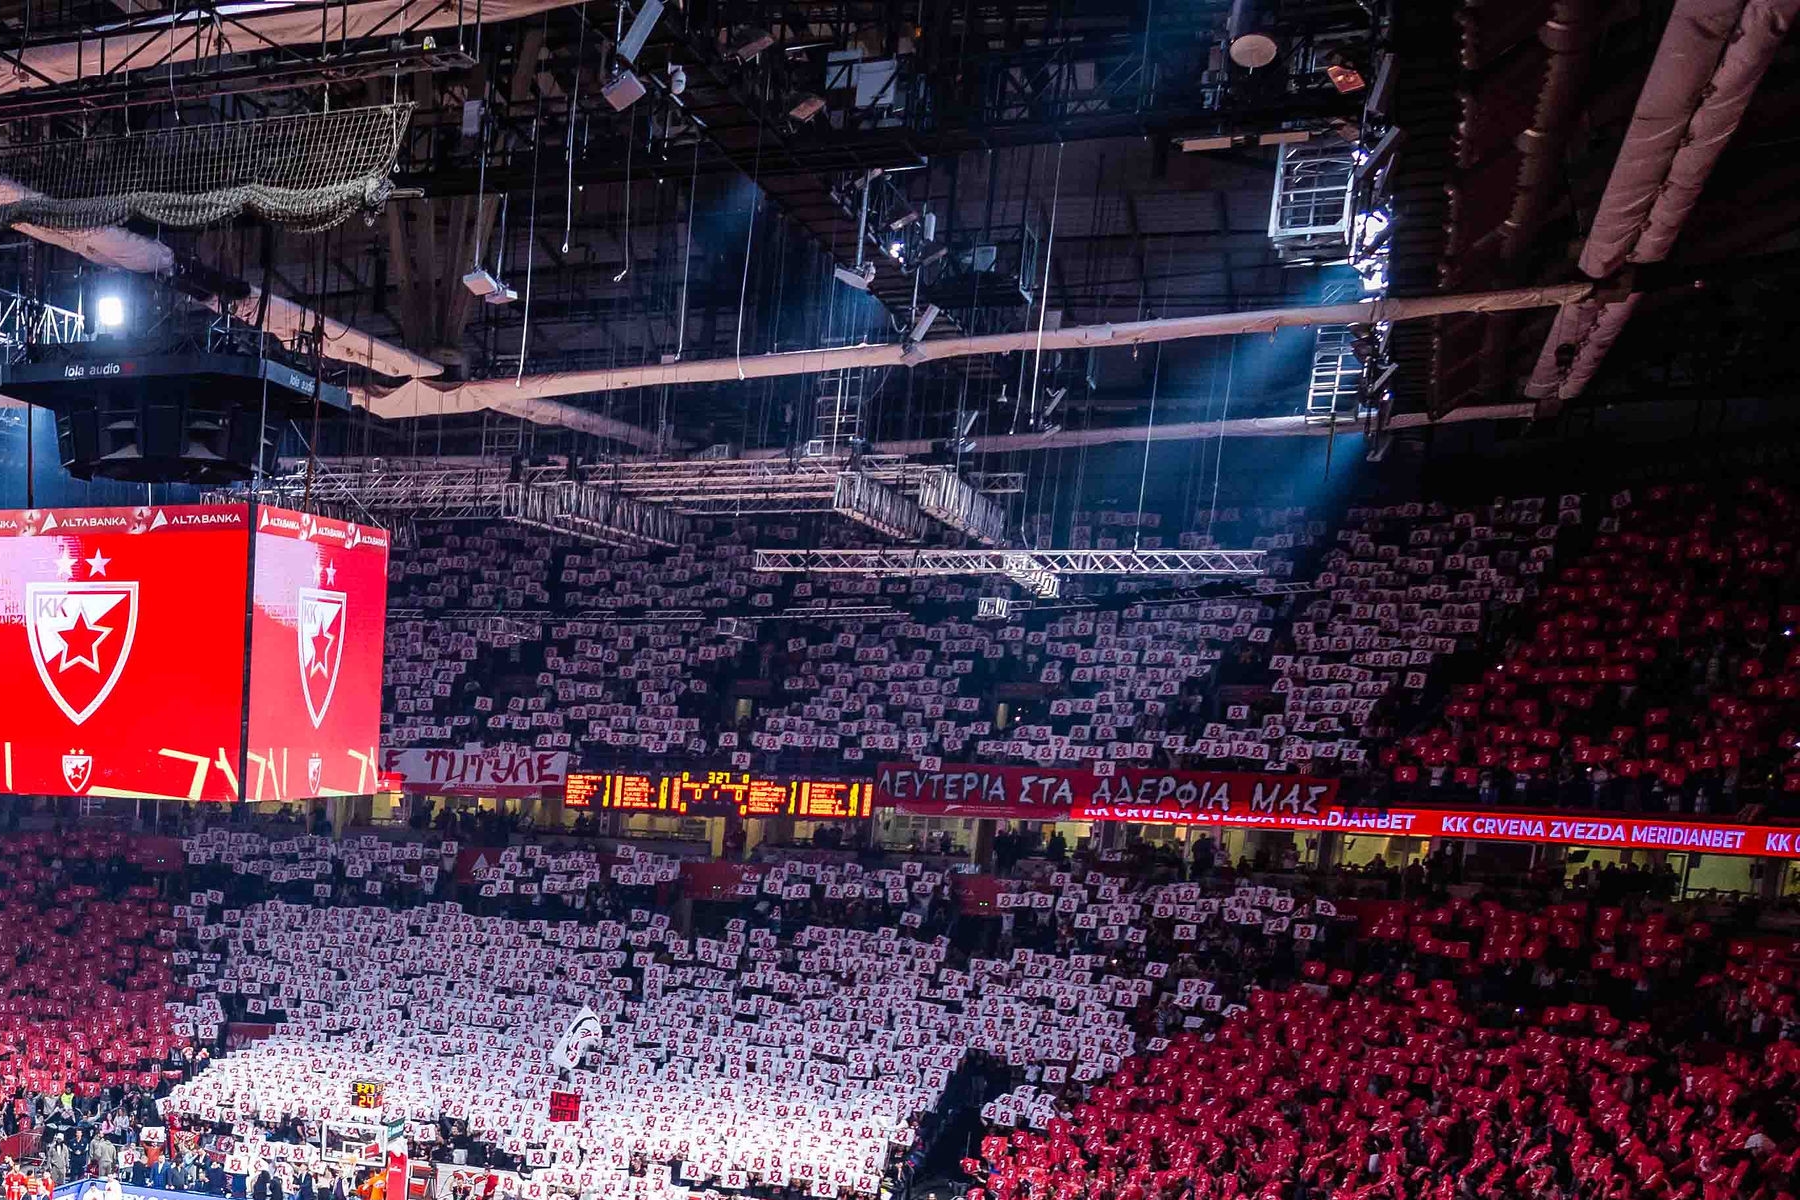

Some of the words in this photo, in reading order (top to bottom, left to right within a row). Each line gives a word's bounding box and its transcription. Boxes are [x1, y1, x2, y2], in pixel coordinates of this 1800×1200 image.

[60, 517, 127, 527] ALTABANKA
[171, 513, 241, 525] ALTABANKA
[39, 597, 68, 618] KK
[1442, 816, 1469, 834] KK
[1472, 817, 1545, 838] CRVENA
[1548, 820, 1625, 842] ZVEZDA
[1631, 825, 1746, 851] MERIDIANBET
[1765, 832, 1791, 853] KK
